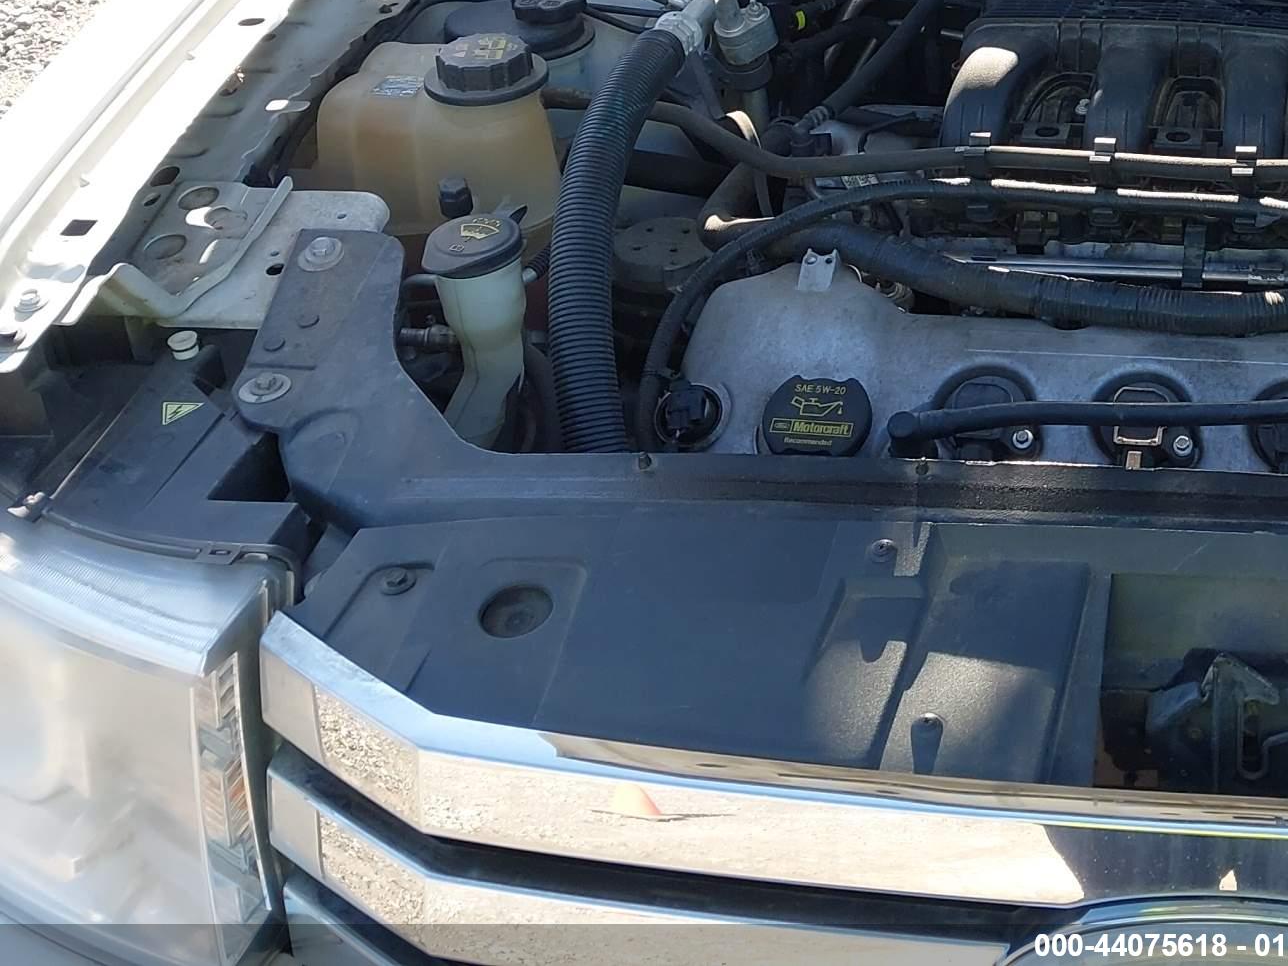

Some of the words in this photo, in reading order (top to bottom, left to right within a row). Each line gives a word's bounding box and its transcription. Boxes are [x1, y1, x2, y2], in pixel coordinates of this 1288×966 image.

[794, 384, 814, 393] SAE
[816, 385, 847, 395] 5W-20
[793, 421, 849, 435] Motorcraft
[784, 437, 833, 446] Recommended
